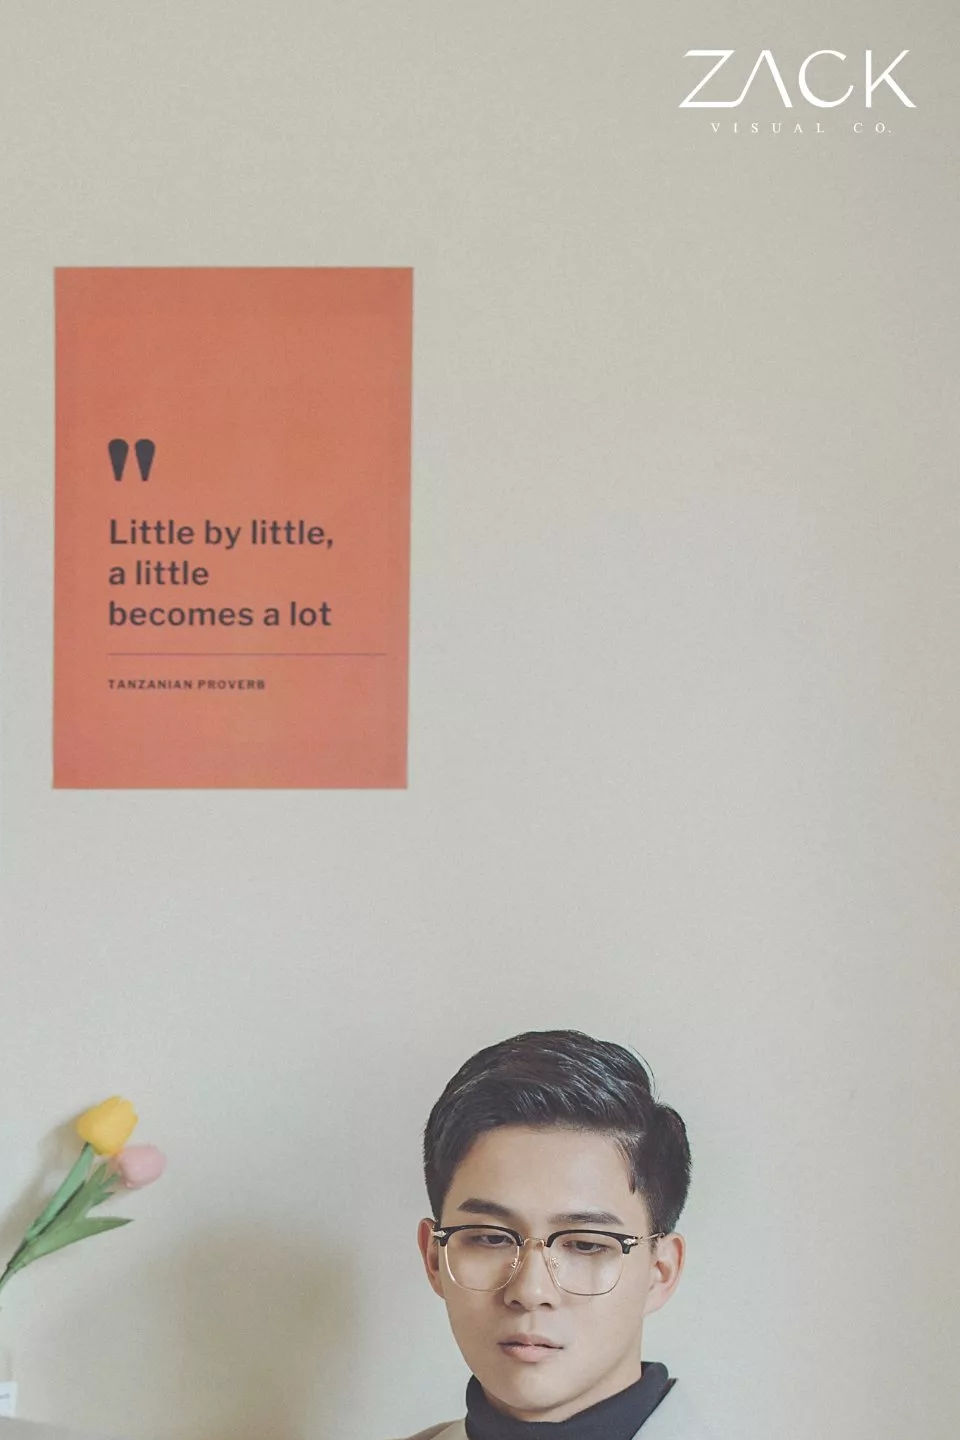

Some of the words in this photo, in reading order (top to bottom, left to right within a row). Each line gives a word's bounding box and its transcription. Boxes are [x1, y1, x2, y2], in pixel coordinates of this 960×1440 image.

[109, 519, 195, 545] Little
[205, 519, 241, 550] by
[251, 519, 334, 549] little,
[108, 566, 126, 585] a
[136, 560, 209, 585] little
[109, 601, 253, 626] becomes
[263, 607, 280, 626] a
[291, 601, 332, 626] lot
[108, 679, 192, 690] TANZANIAN
[198, 679, 265, 690] PROVERB
